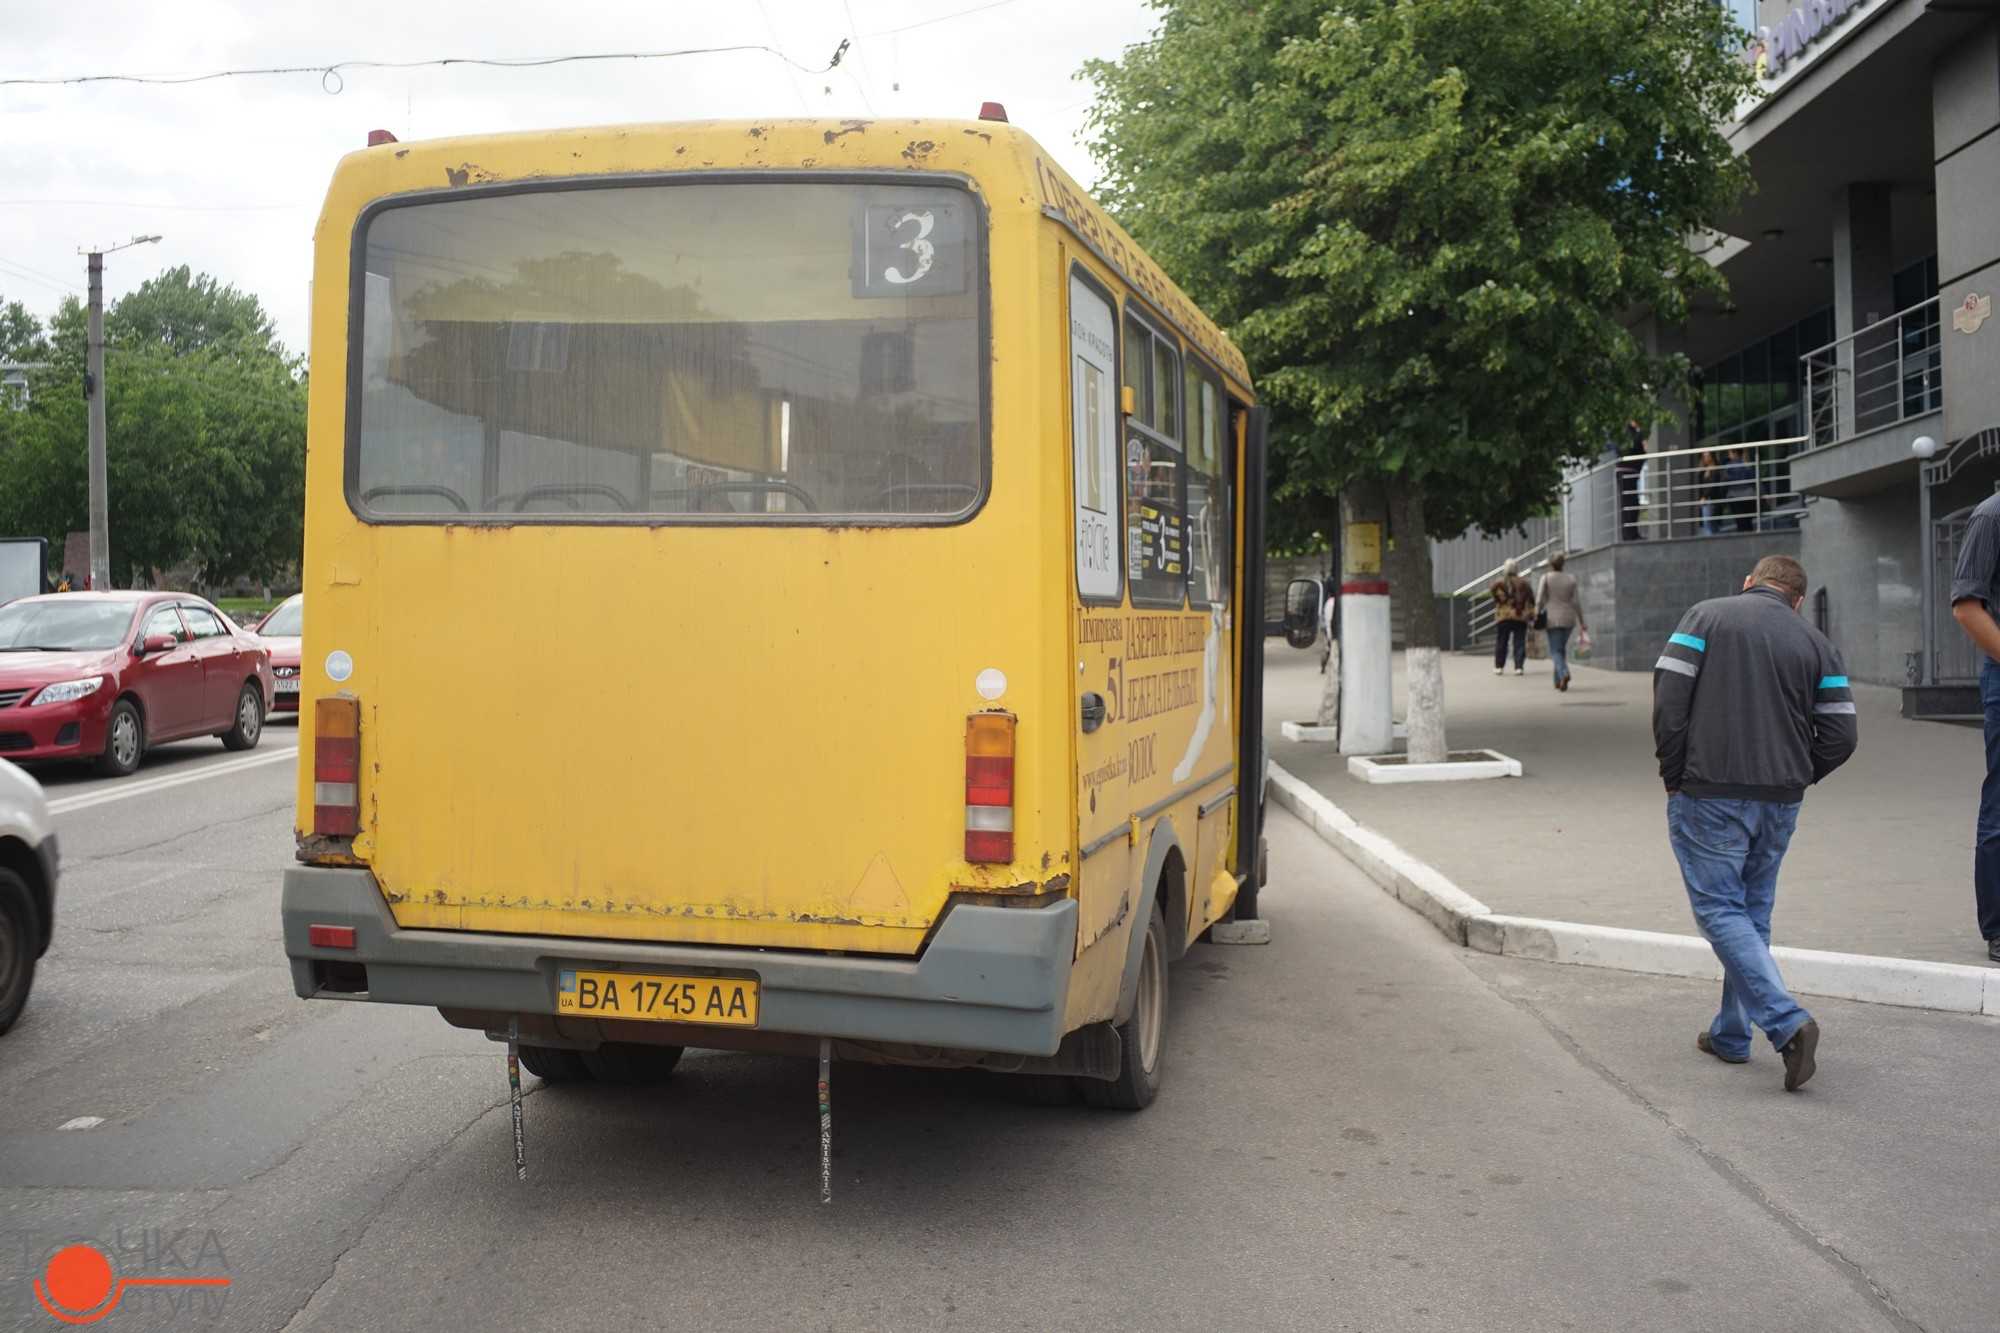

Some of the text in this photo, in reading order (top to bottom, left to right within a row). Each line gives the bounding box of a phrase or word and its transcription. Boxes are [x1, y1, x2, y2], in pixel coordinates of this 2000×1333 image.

[885, 211, 934, 283] 3
[1106, 657, 1125, 724] 51
[561, 998, 574, 1008] UA
[579, 979, 747, 1018] BA 1745 AA
[822, 1131, 831, 1195] ANTISTATIC
